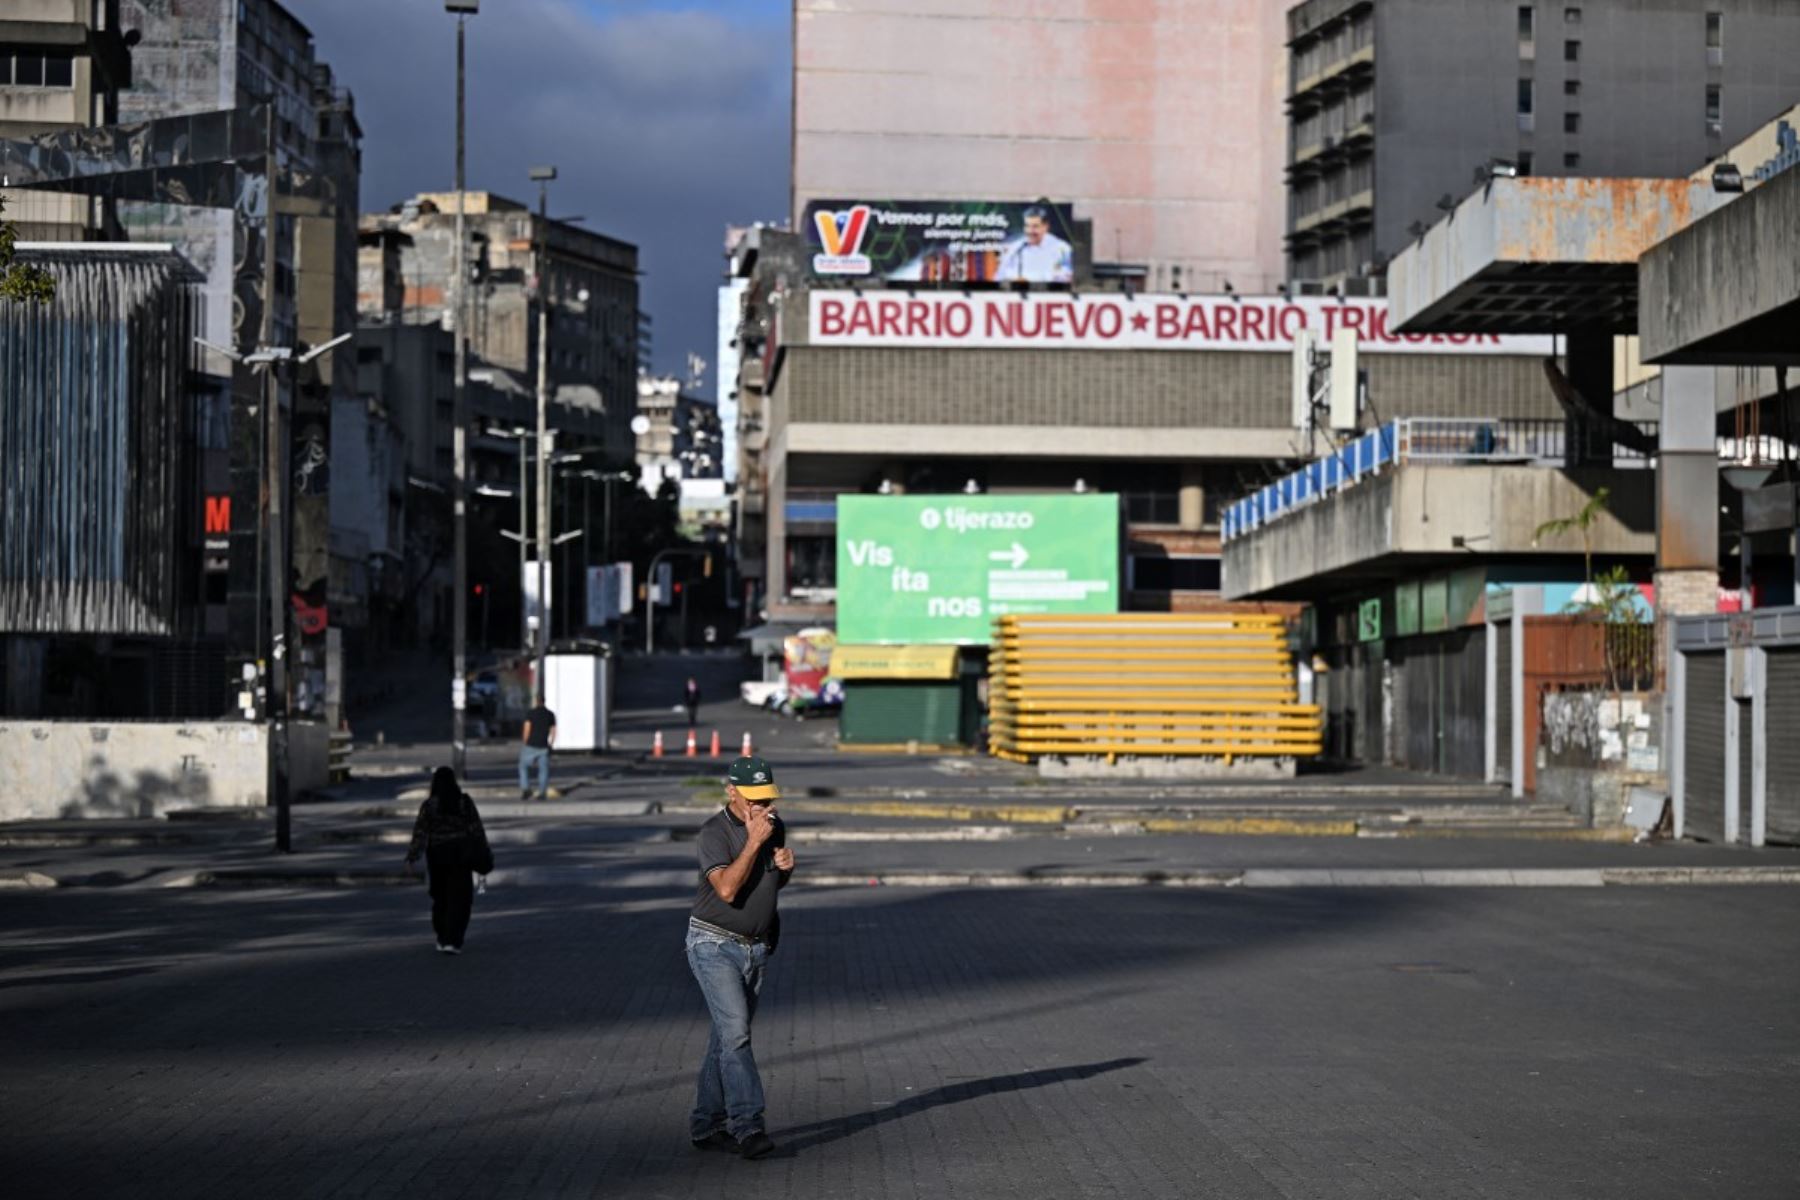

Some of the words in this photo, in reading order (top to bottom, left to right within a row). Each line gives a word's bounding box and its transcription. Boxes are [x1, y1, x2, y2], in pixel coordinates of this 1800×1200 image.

[935, 213, 966, 227] por
[924, 229, 971, 240] siempre
[819, 300, 973, 338] BARRIO
[985, 301, 1123, 339] NUEVO
[1155, 303, 1308, 342] BARRIO
[205, 496, 231, 533] M
[945, 507, 1034, 533] tijerazo
[846, 540, 893, 567] Vis
[928, 597, 982, 617] nos
